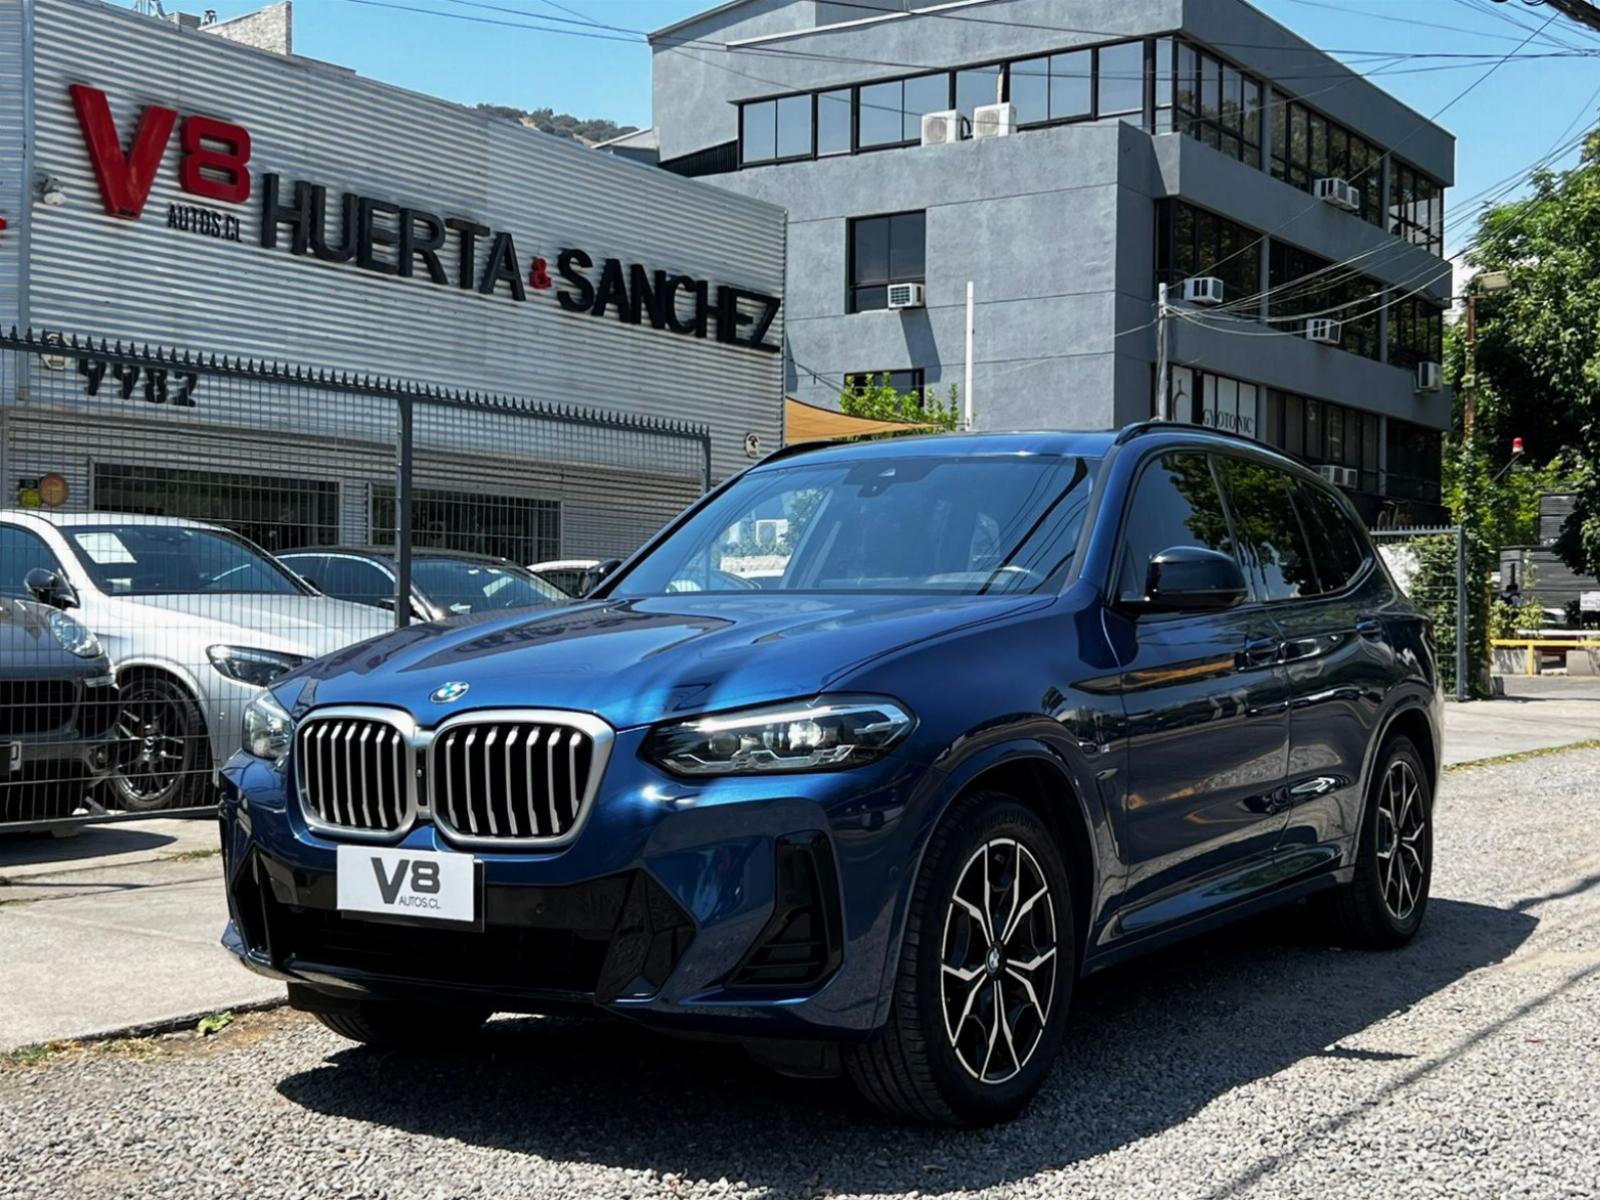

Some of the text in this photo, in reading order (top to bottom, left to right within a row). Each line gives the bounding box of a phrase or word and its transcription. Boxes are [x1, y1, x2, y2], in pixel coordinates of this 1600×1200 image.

[69, 83, 252, 220] V8
[166, 203, 243, 243] AUTOS.CL
[260, 172, 782, 353] HUERTA & SANCHEZ
[370, 857, 441, 905] V8
[398, 895, 441, 910] AUTOS.CL
